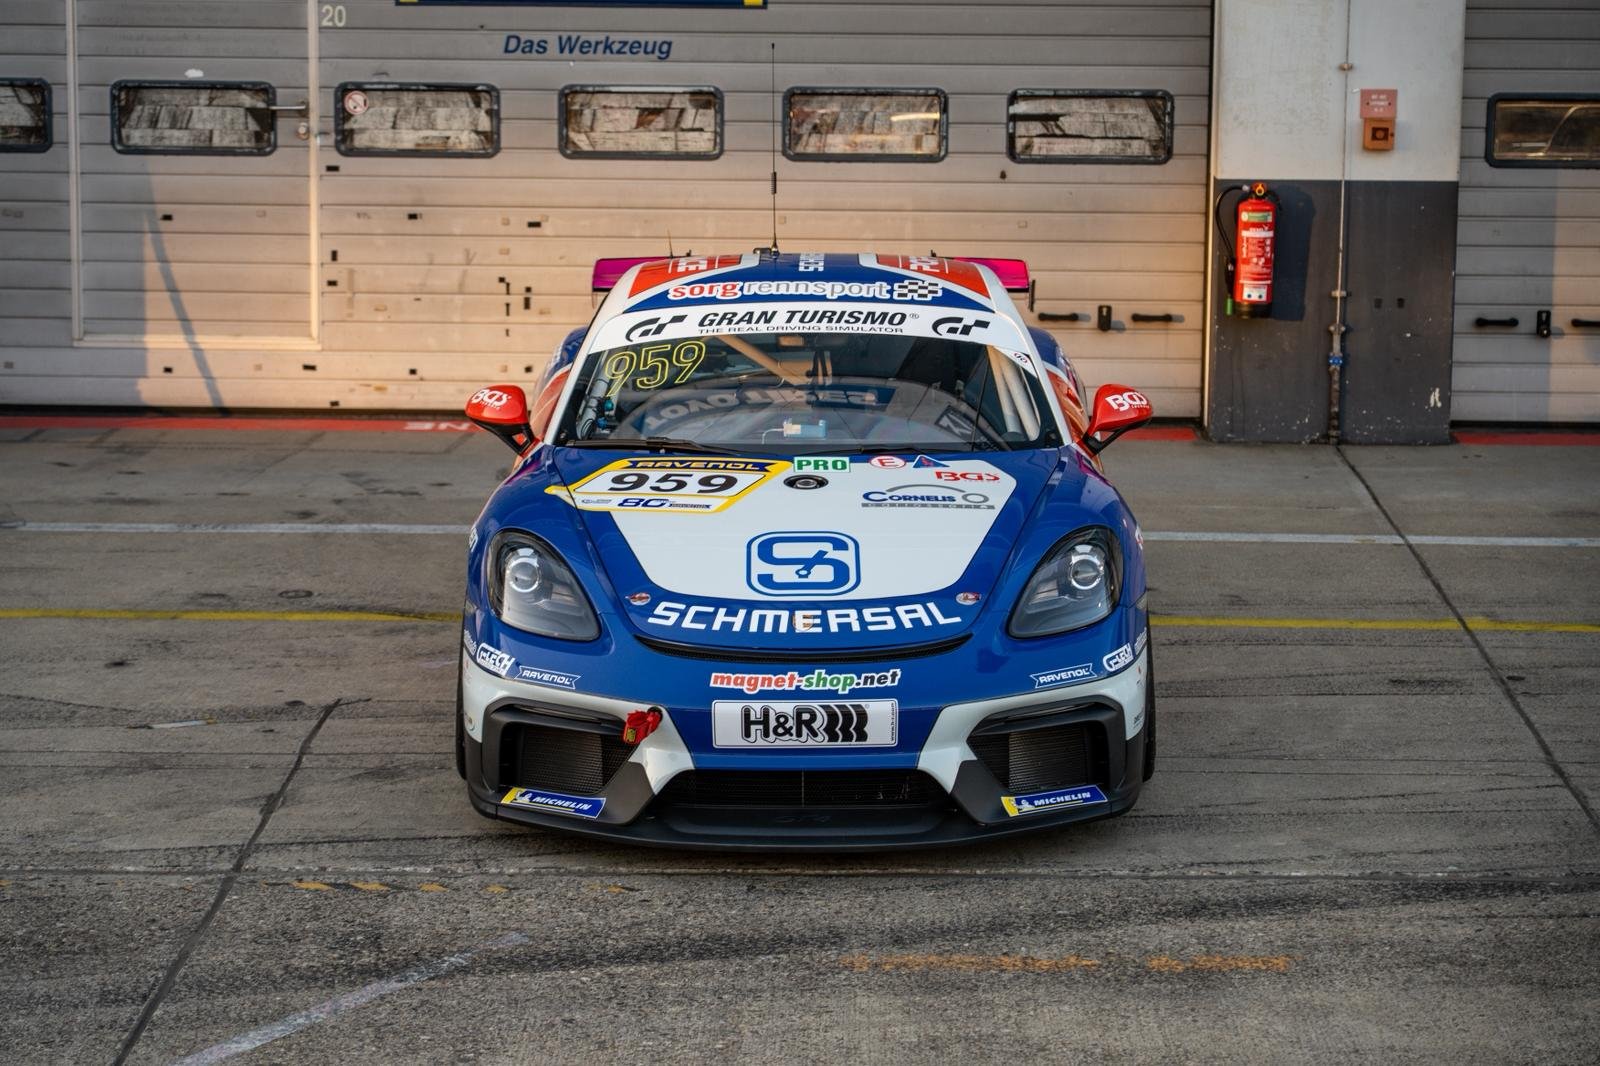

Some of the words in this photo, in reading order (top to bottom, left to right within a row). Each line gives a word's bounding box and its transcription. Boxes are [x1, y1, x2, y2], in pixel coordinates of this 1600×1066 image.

[320, 4, 346, 27] 20
[503, 34, 549, 55] Das
[557, 34, 673, 60] Werkzeug
[698, 310, 778, 328] GRAN
[825, 325, 904, 333] SIMULATOR
[604, 340, 706, 398] 959
[634, 460, 761, 472] RAVENOL
[796, 458, 848, 471] PRO
[877, 457, 897, 467] E
[607, 472, 738, 494] 959
[647, 601, 962, 634] SCHMERSAL
[522, 669, 574, 686] RAVENOL
[711, 669, 900, 693] magnet-shop.net
[1039, 666, 1091, 684] RAVENOL
[741, 705, 826, 742] H&R
[532, 795, 593, 811] MICHELIN
[1033, 791, 1092, 807] MICHELIN
